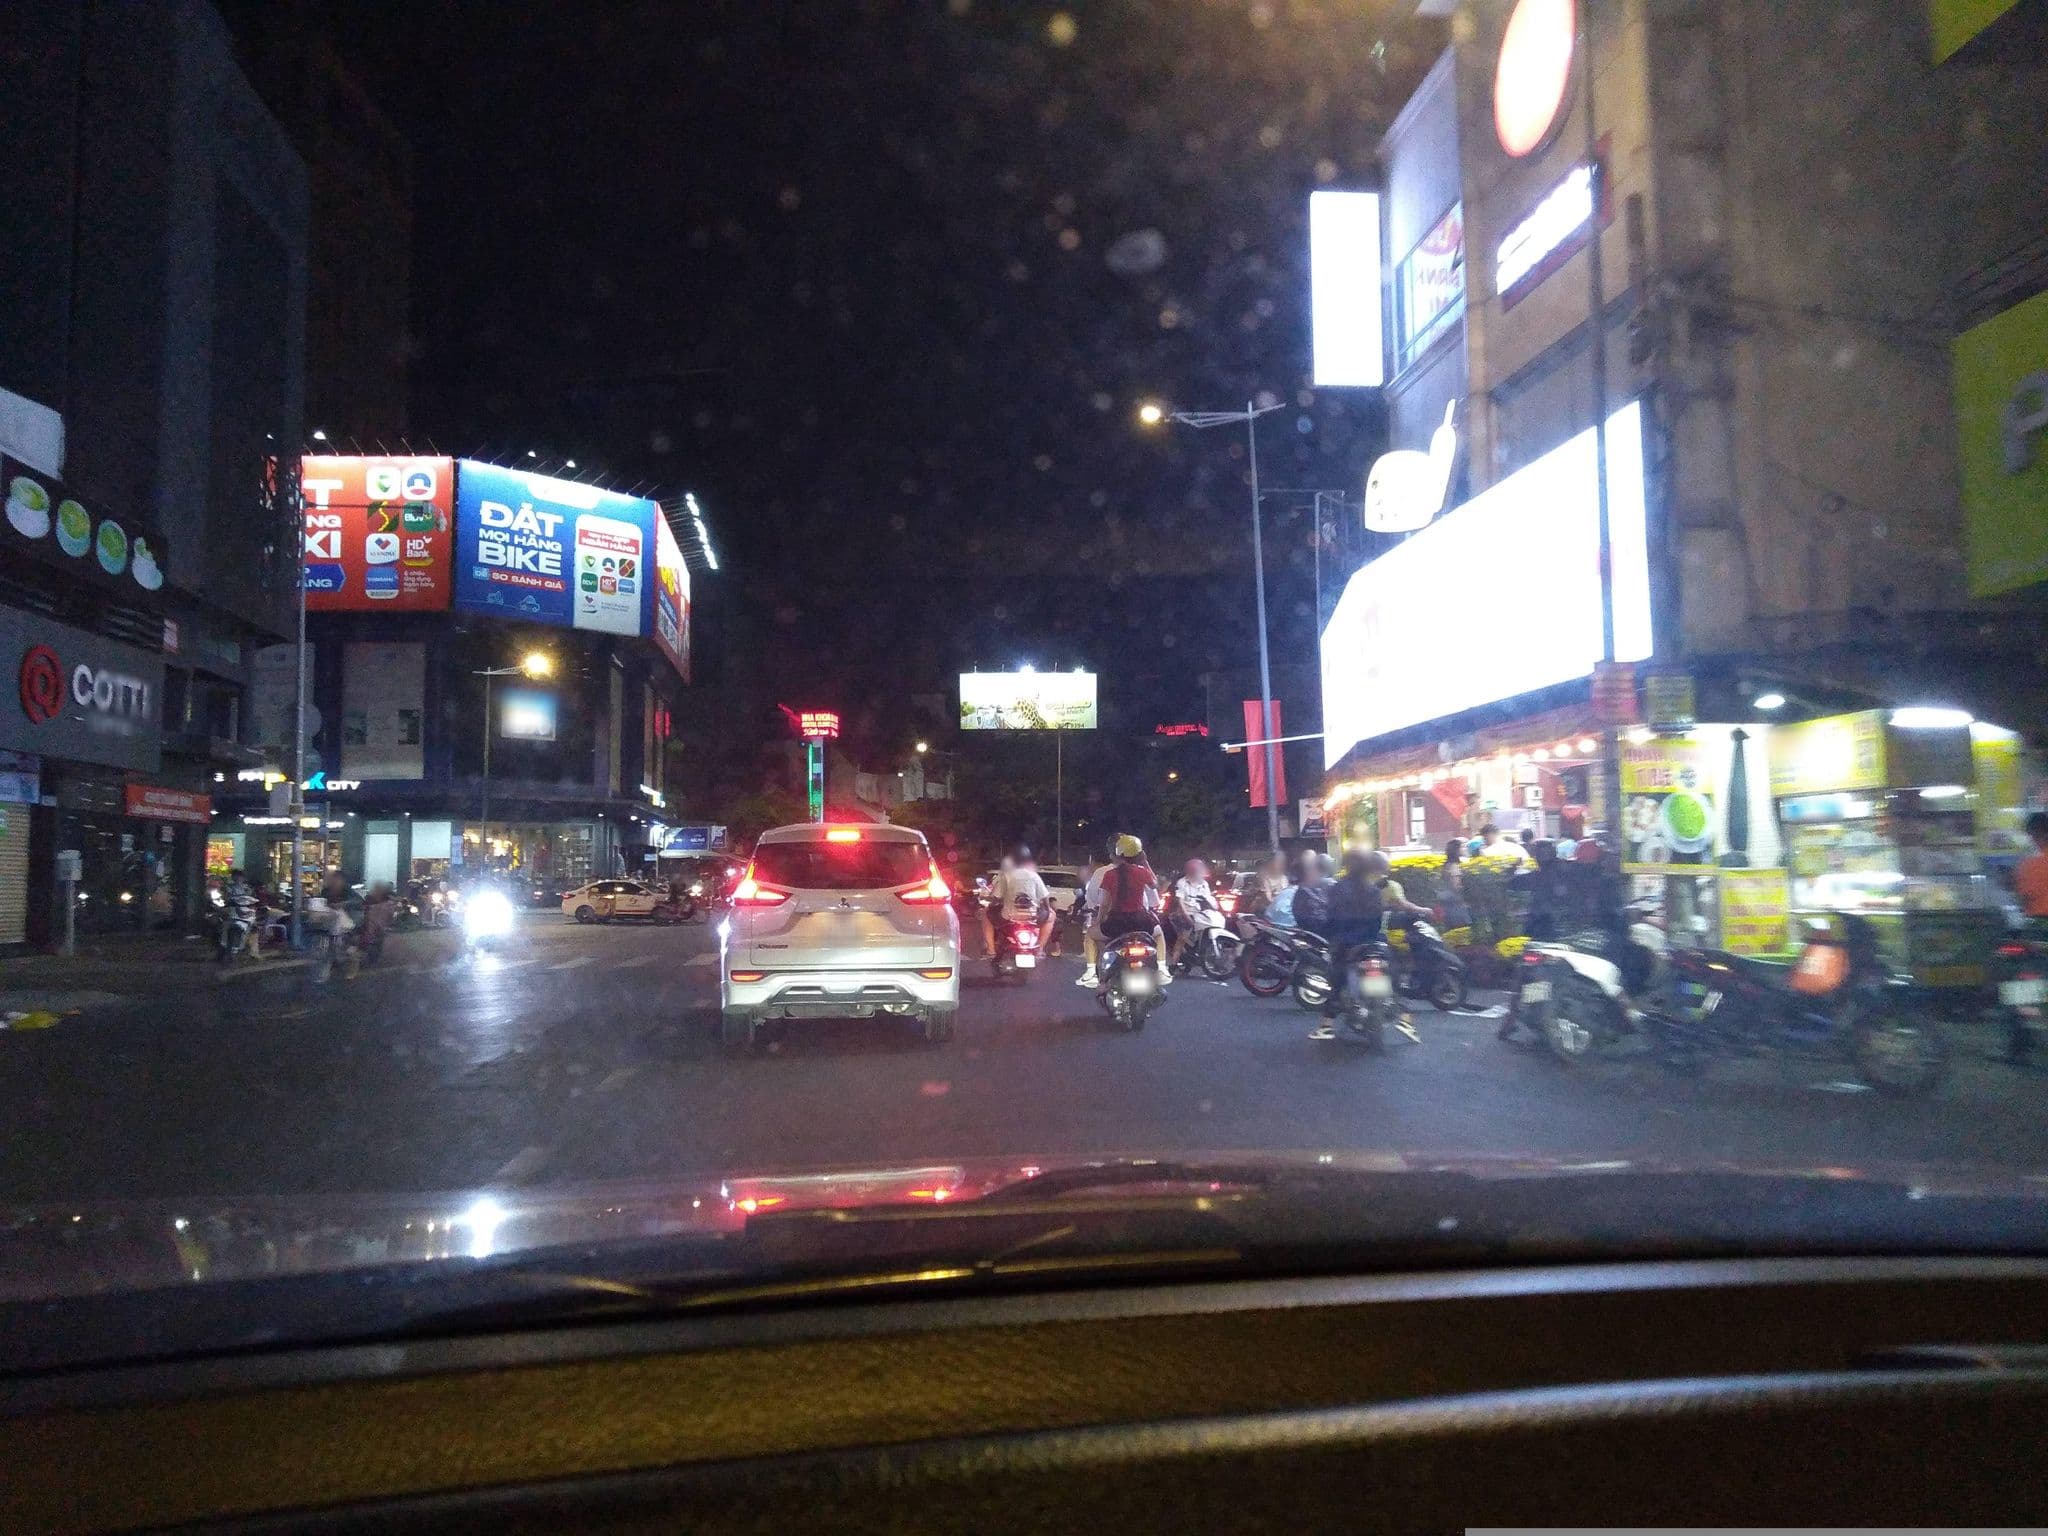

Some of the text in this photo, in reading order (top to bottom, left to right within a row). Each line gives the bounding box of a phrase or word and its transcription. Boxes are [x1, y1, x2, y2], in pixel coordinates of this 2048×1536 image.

[480, 500, 564, 538] ĐẶT
[479, 528, 510, 544] MỌI
[407, 540, 424, 550] HD
[407, 550, 429, 558] Bank
[479, 540, 562, 576] BIKE
[492, 573, 508, 581] SO
[73, 664, 148, 719] COTTI
